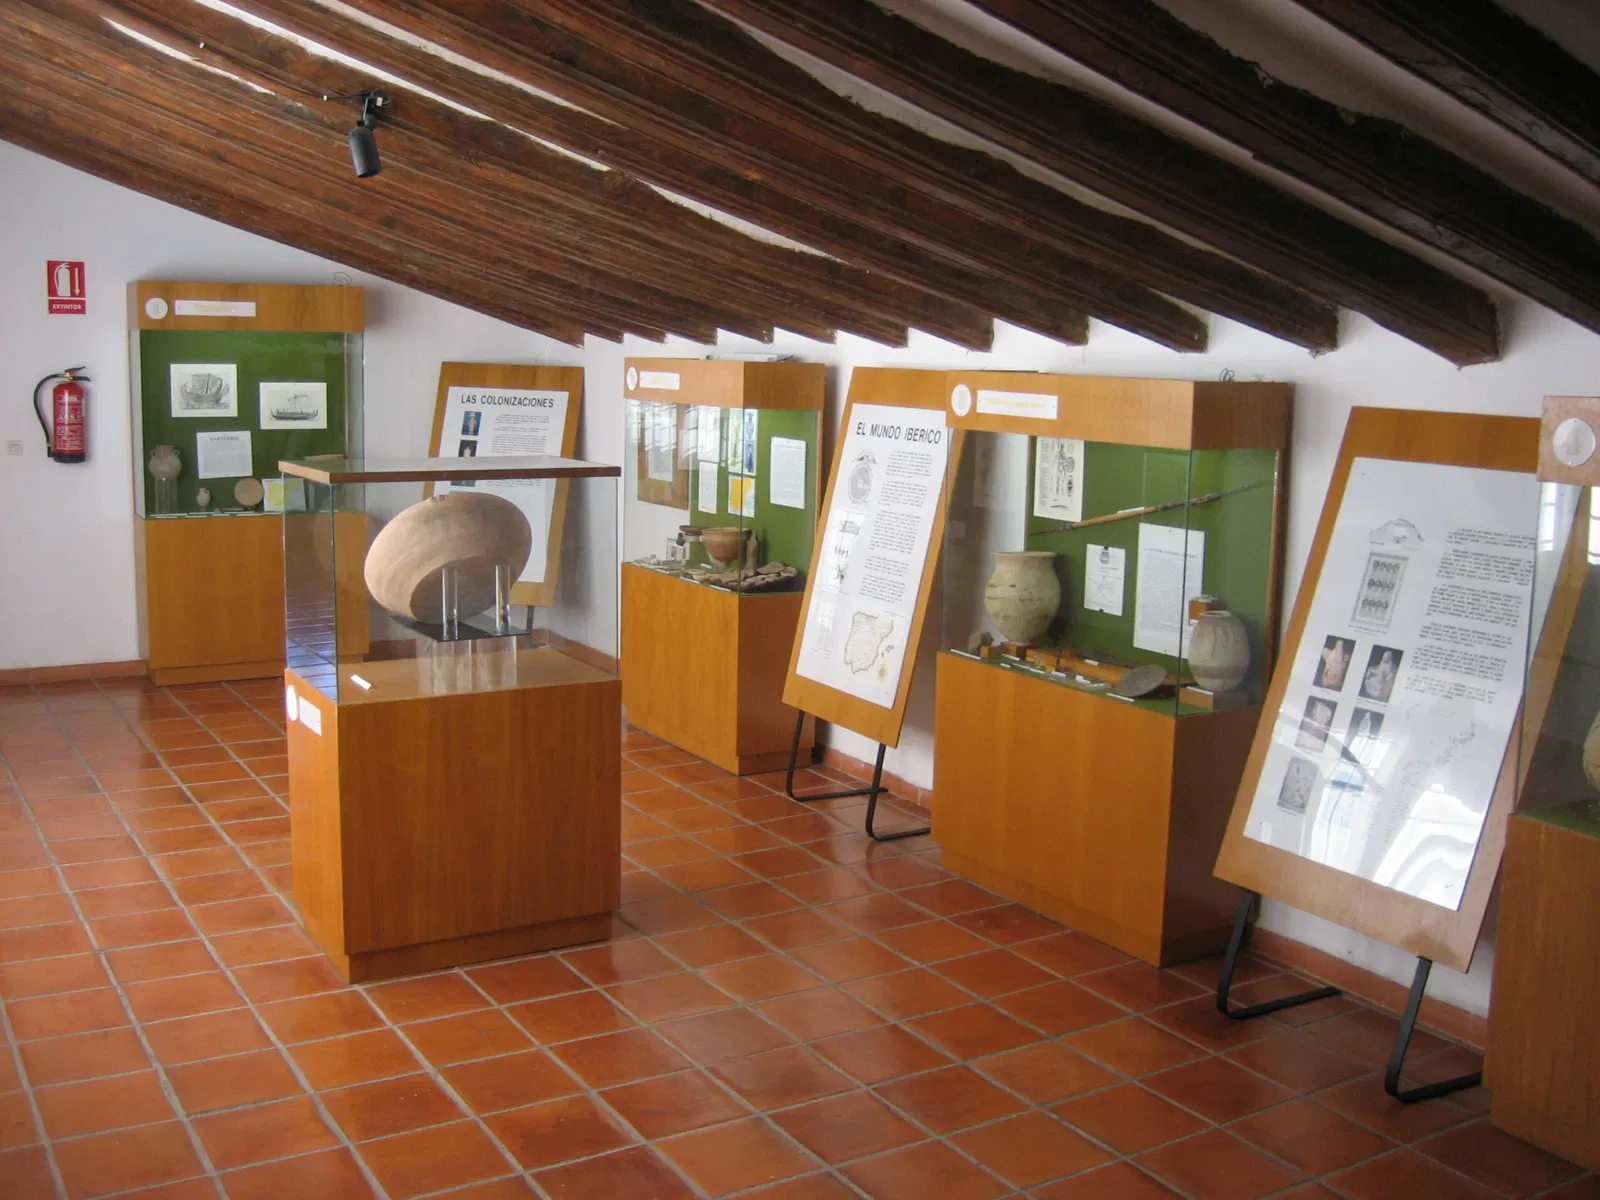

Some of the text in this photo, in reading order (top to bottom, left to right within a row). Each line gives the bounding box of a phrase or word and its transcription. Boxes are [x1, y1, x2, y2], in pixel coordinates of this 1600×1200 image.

[52, 303, 82, 311] EXTINTOR
[461, 394, 554, 408] LAS COLONIZACIONES
[856, 422, 941, 444] EL MUNDO IBERICO
